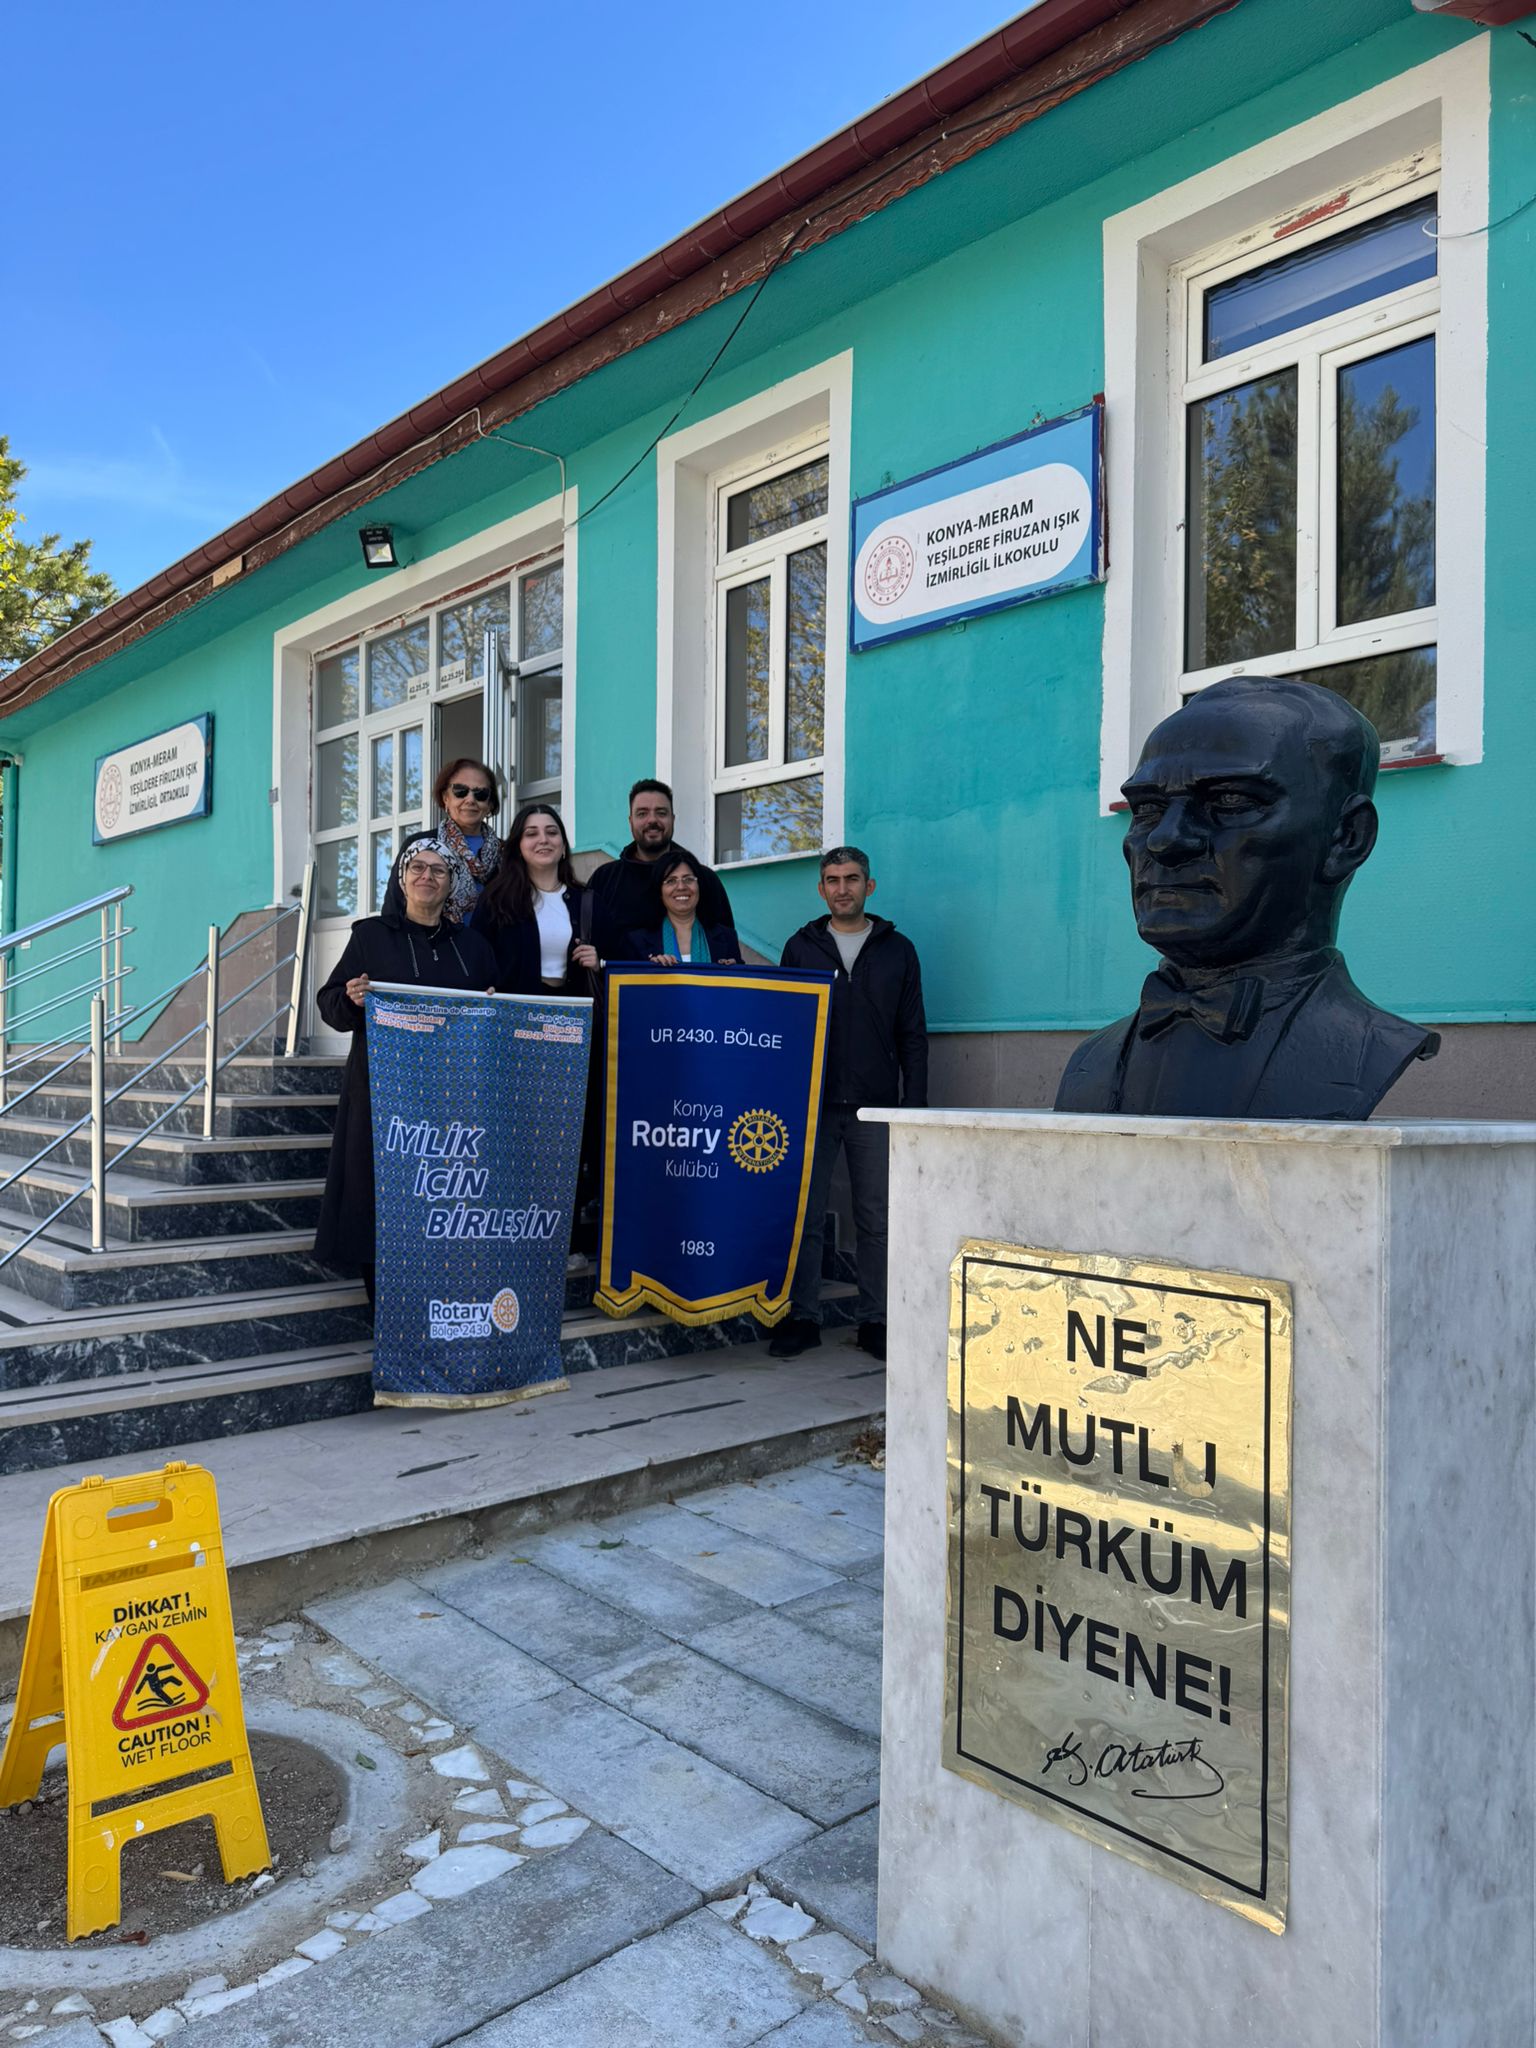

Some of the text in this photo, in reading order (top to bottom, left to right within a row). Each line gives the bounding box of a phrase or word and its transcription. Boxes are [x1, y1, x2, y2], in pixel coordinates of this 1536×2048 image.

[926, 499, 1034, 546] KONYA-MERAM
[927, 509, 1080, 567] YEŞİLDERE FİRUZAN IŞIK
[926, 557, 990, 588] İZMİRLİGİL
[993, 538, 1059, 568] İLKOKULU
[129, 746, 178, 776] KONYA-MERAM
[419, 1004, 448, 1014] Martins
[449, 1006, 460, 1015] de
[461, 1006, 496, 1016] Camargo
[650, 1028, 782, 1049] UR 2430. BÖLGE
[673, 1099, 723, 1122] Konya
[387, 1116, 485, 1157] İYİLİK
[632, 1120, 721, 1154] Rotary
[414, 1162, 488, 1200] İÇİN
[665, 1159, 719, 1179] Kulübü
[426, 1203, 561, 1242] BİRLEŞİN
[680, 1240, 715, 1256] 1983
[431, 1302, 490, 1322] Rotary
[431, 1324, 490, 1339] Bölge 2430
[1067, 1309, 1148, 1378] NE
[981, 1481, 1247, 1619] TÜRKÜM
[95, 1606, 207, 1644] KAYGAN ZEMİN
[994, 1584, 1231, 1726] DİYENE!
[118, 1717, 199, 1753] CAUTION
[121, 1731, 211, 1768] WET FLOOR
